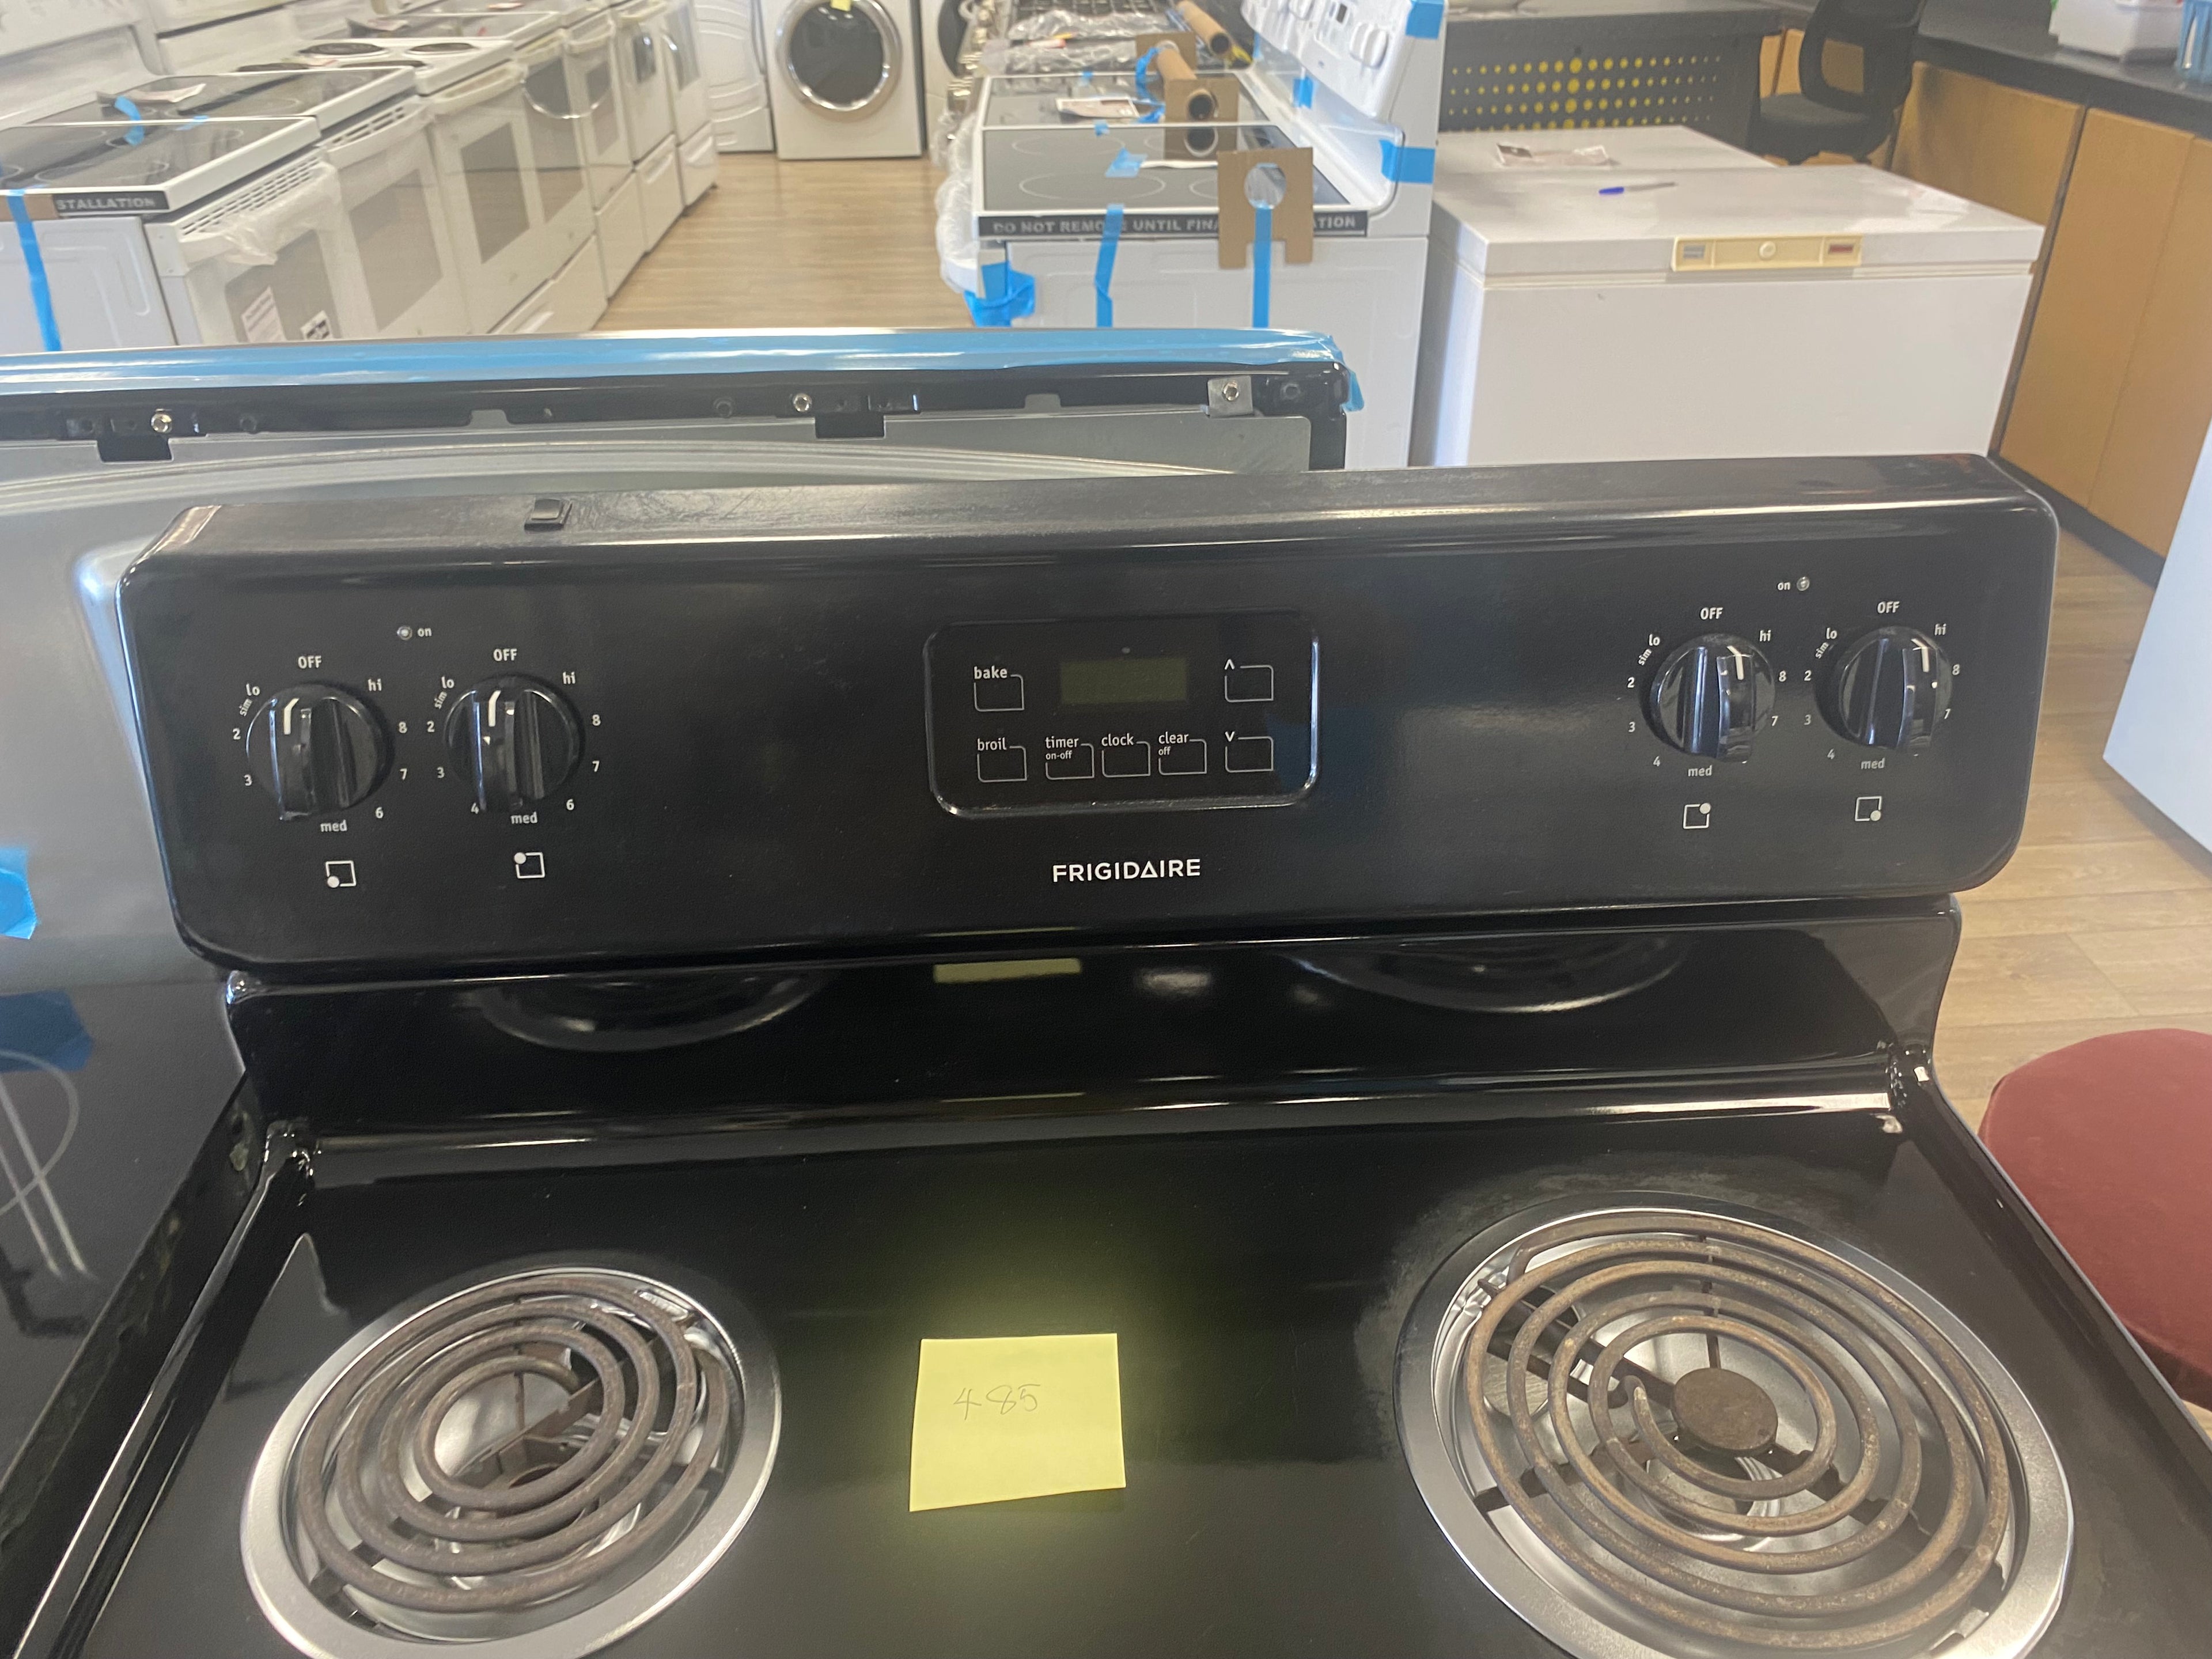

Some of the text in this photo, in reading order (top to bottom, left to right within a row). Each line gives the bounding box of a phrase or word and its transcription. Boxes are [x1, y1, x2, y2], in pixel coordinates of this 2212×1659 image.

[57, 196, 156, 210] STALLATION
[993, 221, 1016, 233] DO
[1021, 221, 1055, 233] NOT
[1059, 220, 1125, 232] REMO
[1132, 218, 1181, 231] UNTIL
[1777, 581, 1791, 590] on
[1700, 607, 1724, 620] OFF
[1877, 601, 1900, 613] OFF
[417, 627, 432, 637] on
[1759, 629, 1771, 642] hi
[1825, 627, 1838, 640] lo
[1934, 623, 1947, 636] hi
[1649, 634, 1660, 646] lo
[493, 648, 518, 662] OFF
[297, 655, 322, 669] OFF
[974, 665, 1008, 680] bake
[1778, 670, 1787, 683] 8
[1804, 669, 1812, 682] 2
[1952, 664, 1960, 676] 8
[441, 676, 455, 689] lo
[562, 671, 576, 685] hi
[1627, 676, 1635, 688] 2
[245, 683, 260, 696] lo
[368, 678, 382, 692] hi
[592, 714, 601, 726] 8
[1771, 715, 1779, 727] 7
[1804, 714, 1812, 726] 3
[398, 721, 408, 734] 8
[426, 721, 435, 733] 2
[1628, 721, 1636, 733] 3
[232, 728, 241, 740] 2
[1101, 732, 1135, 747] clock
[1158, 731, 1189, 745] clear
[977, 737, 1007, 751] broil
[1045, 735, 1080, 749] timer
[1045, 749, 1073, 760] on-off
[1158, 746, 1172, 756] off
[1827, 748, 1835, 760] 4
[592, 760, 600, 772] 7
[1653, 755, 1661, 767] 4
[1861, 757, 1886, 770] med
[400, 768, 408, 781] 7
[437, 766, 445, 779] 3
[1687, 764, 1713, 777] med
[244, 774, 253, 786] 3
[470, 802, 480, 815] 4
[566, 798, 575, 811] 6
[375, 806, 384, 819] 6
[510, 811, 538, 824] med
[320, 819, 348, 832] med
[1052, 858, 1201, 883] FRIGIDAIRE
[953, 1383, 1041, 1421] 485
